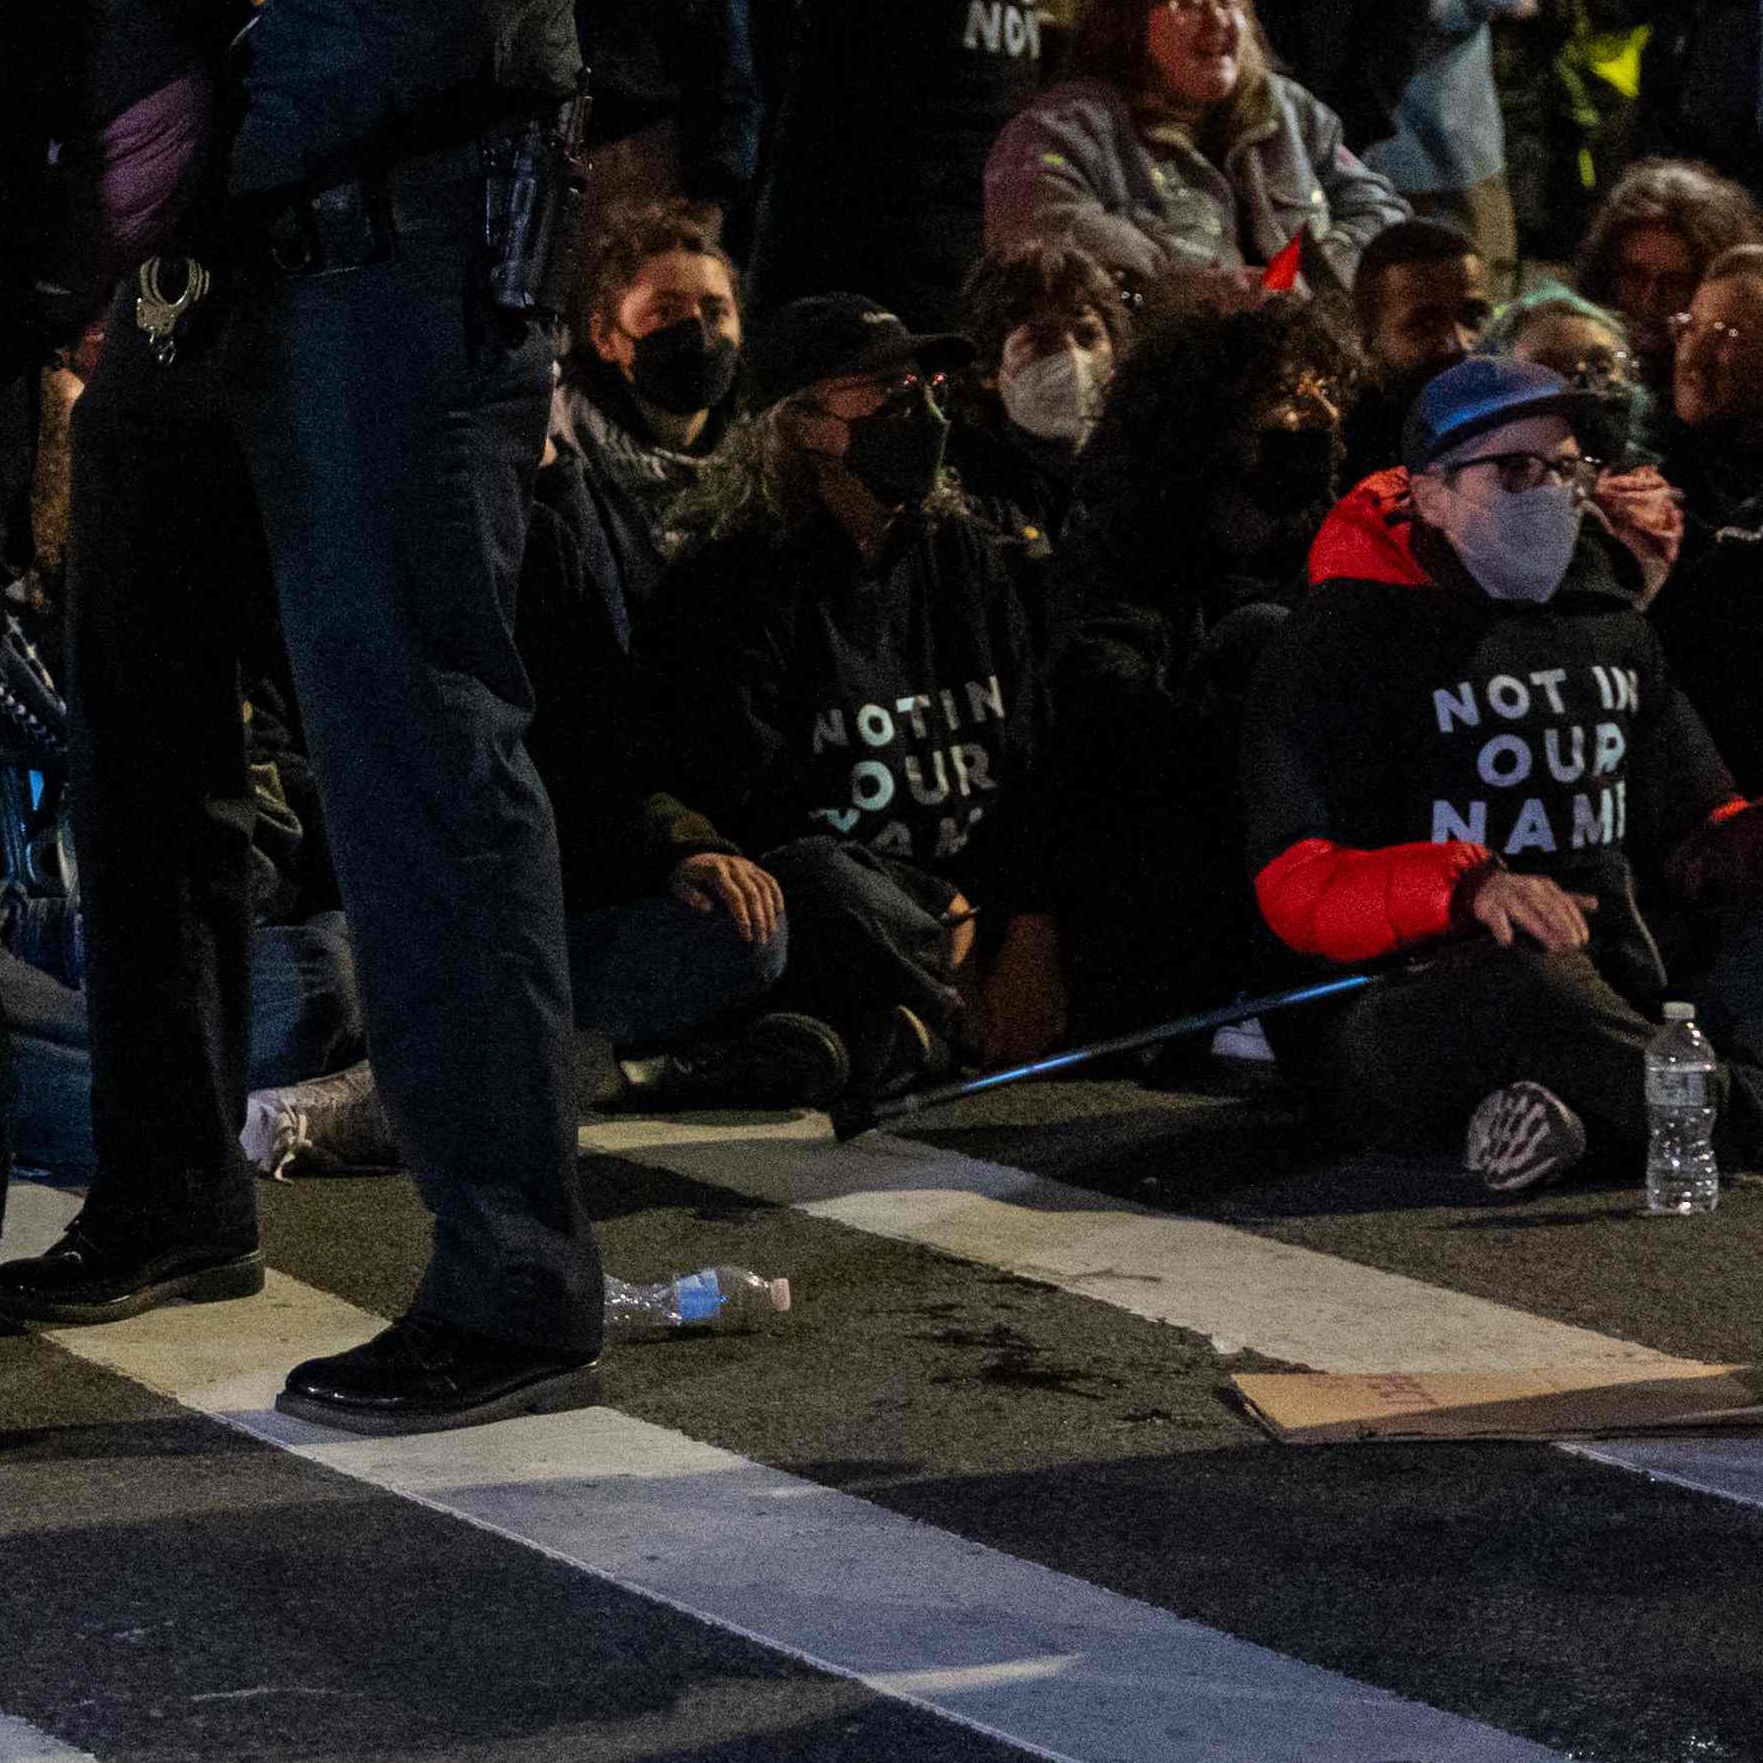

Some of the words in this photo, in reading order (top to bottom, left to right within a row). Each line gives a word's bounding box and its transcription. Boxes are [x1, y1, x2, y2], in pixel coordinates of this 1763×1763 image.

[812, 694, 931, 754] NOT
[939, 674, 1006, 732] IN
[1432, 667, 1568, 734] NOT
[1590, 665, 1640, 719] IN
[850, 742, 998, 812] OUR
[1477, 722, 1626, 788] OUR
